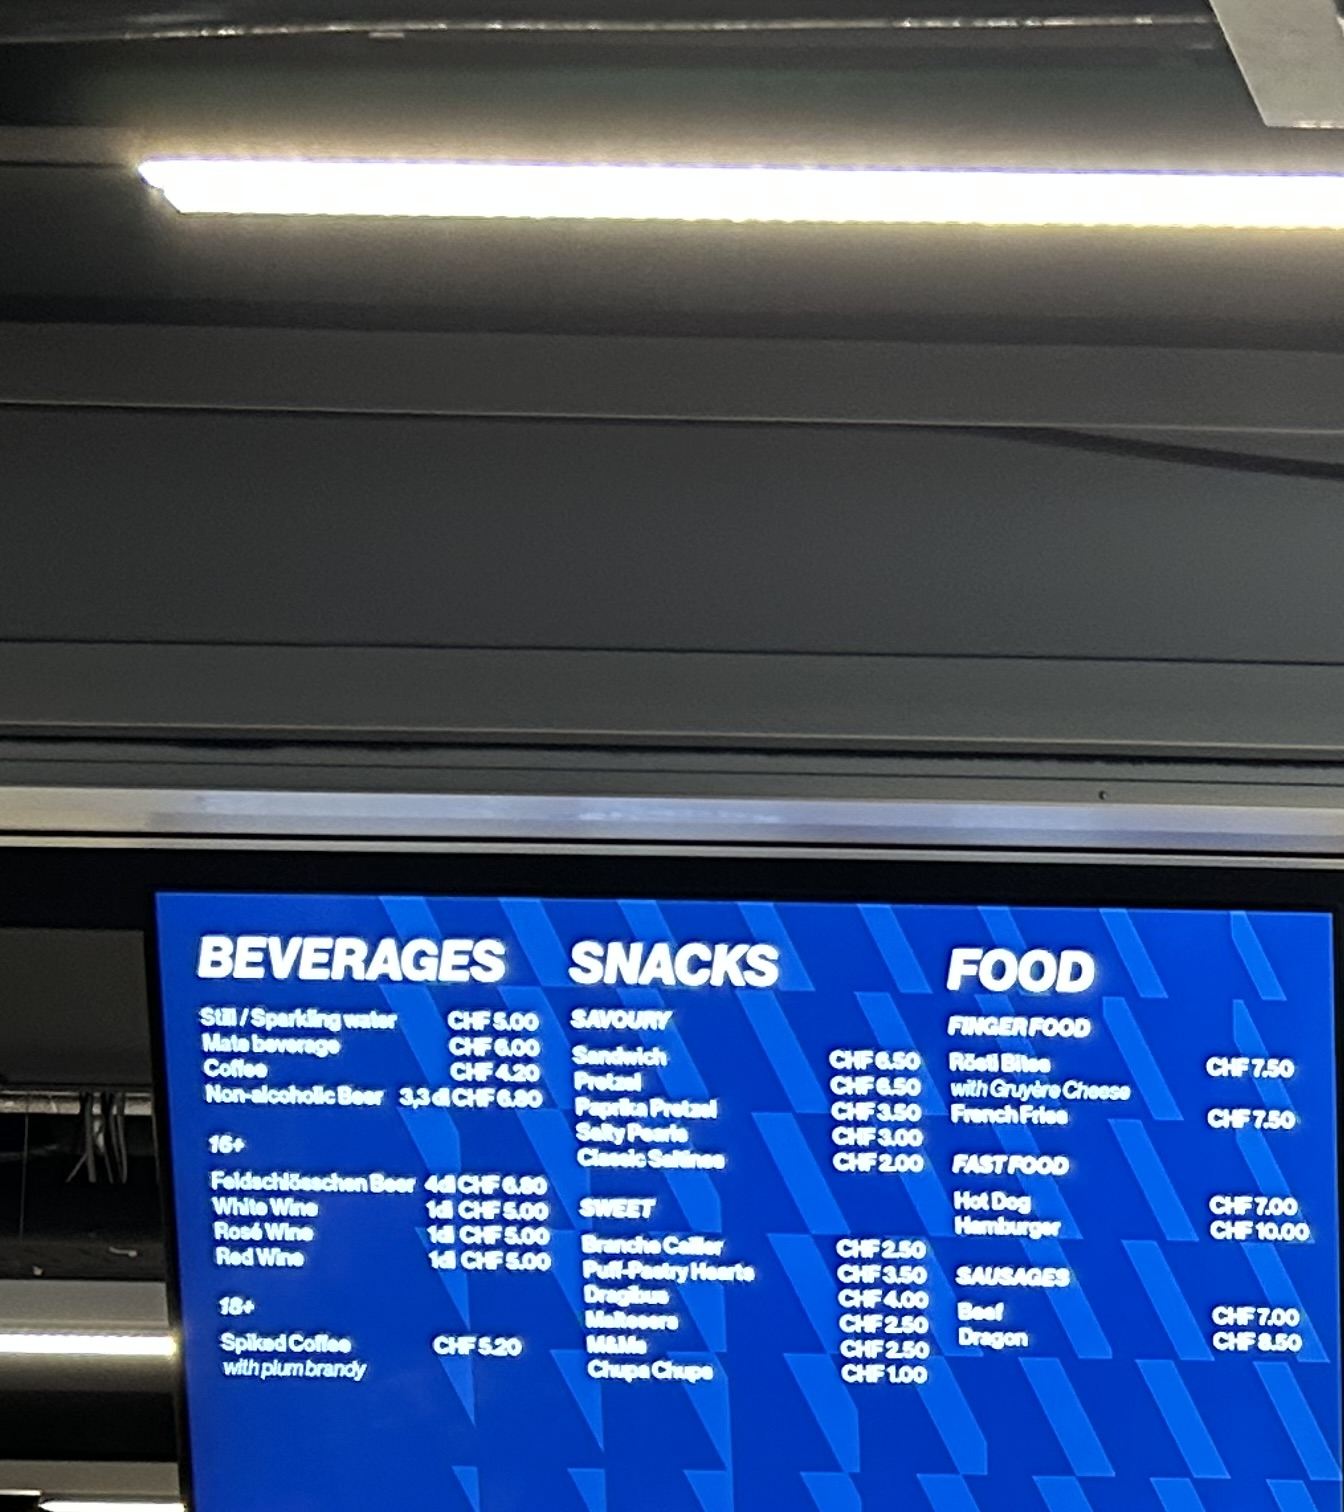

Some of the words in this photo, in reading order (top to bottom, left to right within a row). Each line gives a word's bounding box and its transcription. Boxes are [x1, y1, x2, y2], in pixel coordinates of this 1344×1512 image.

[197, 936, 506, 983] BEVERAGES
[569, 940, 779, 988] SNACKS
[946, 948, 1095, 993] FOOD
[200, 1007, 237, 1027] Still
[251, 1007, 342, 1032] Sparkling
[342, 1010, 398, 1029] water
[447, 1010, 491, 1031] CHF
[493, 1012, 540, 1032] 5.00
[570, 1009, 673, 1030] SAVOURY
[947, 1015, 1029, 1037] FINGER
[1028, 1017, 1091, 1038] FOOD
[251, 1033, 341, 1058] beverage
[448, 1037, 493, 1057] CHF
[494, 1038, 541, 1057] 6.00
[572, 1045, 667, 1066] Sandwich
[829, 1049, 874, 1070] CHF
[875, 1051, 922, 1070] 6.50
[203, 1058, 268, 1078] Coffee
[450, 1062, 494, 1082] CHF
[494, 1063, 540, 1082] 4.20
[205, 1083, 336, 1105] Non-alcoholic
[337, 1085, 384, 1106] Beer
[399, 1087, 431, 1109] 3,3
[431, 1087, 451, 1107] dl
[451, 1087, 495, 1108] CHF
[574, 1071, 642, 1092] Pretzel
[830, 1075, 875, 1095] CHF
[876, 1077, 922, 1097] 6.50
[575, 1096, 648, 1120] Paprika
[649, 1097, 718, 1119] Pretzel
[831, 1101, 876, 1122] CHF
[876, 1103, 922, 1122] 3.50
[209, 1135, 245, 1154] 16+
[575, 1122, 626, 1145] Salty
[832, 1126, 877, 1146] CHF
[877, 1127, 924, 1147] 3.00
[577, 1147, 647, 1168] Classic
[833, 1152, 878, 1172] CHF
[878, 1153, 924, 1173] 2.00
[952, 1153, 1008, 1175] FAST
[1008, 1155, 1070, 1176] FOOD
[369, 1173, 416, 1193] Beer
[424, 1174, 457, 1194] 4dl
[457, 1174, 501, 1195] CHF
[211, 1196, 268, 1216] White
[269, 1197, 319, 1217] Wine
[426, 1199, 454, 1219] 1dl
[457, 1200, 501, 1220] CHF
[502, 1201, 549, 1221] 5.00
[579, 1198, 656, 1219] SWEET
[214, 1221, 263, 1241] Rosé
[264, 1222, 314, 1241] Wine
[427, 1225, 455, 1244] 1dl
[459, 1225, 503, 1245] CHF
[504, 1226, 551, 1246] 5.00
[216, 1246, 254, 1266] Red
[255, 1247, 304, 1267] Wine
[428, 1250, 457, 1269] 1dl
[460, 1250, 504, 1270] CHF
[505, 1251, 552, 1272] 5.00
[836, 1238, 881, 1259] CHF
[881, 1239, 927, 1259] 2.50
[690, 1261, 755, 1282] Hearts
[837, 1264, 882, 1284] CHF
[882, 1265, 928, 1285] 3.50
[955, 1266, 1071, 1287] SAUSAGES
[219, 1296, 255, 1315] 18+
[838, 1289, 883, 1308] CHF
[883, 1290, 930, 1309] 4.00
[839, 1314, 884, 1333] CHF
[884, 1315, 929, 1334] 2.50
[220, 1332, 287, 1355] Spiked
[288, 1334, 352, 1353] Coffee
[433, 1335, 477, 1355] CHF
[477, 1337, 523, 1356] 5.20
[840, 1339, 884, 1359] CHF
[885, 1340, 930, 1359] 2.50
[223, 1358, 260, 1376] with
[260, 1359, 304, 1380] plum
[304, 1359, 367, 1381] brandy
[587, 1359, 651, 1383] Chupa
[651, 1360, 714, 1383] Chups
[841, 1363, 886, 1383] CHF
[886, 1365, 928, 1384] 1.00
